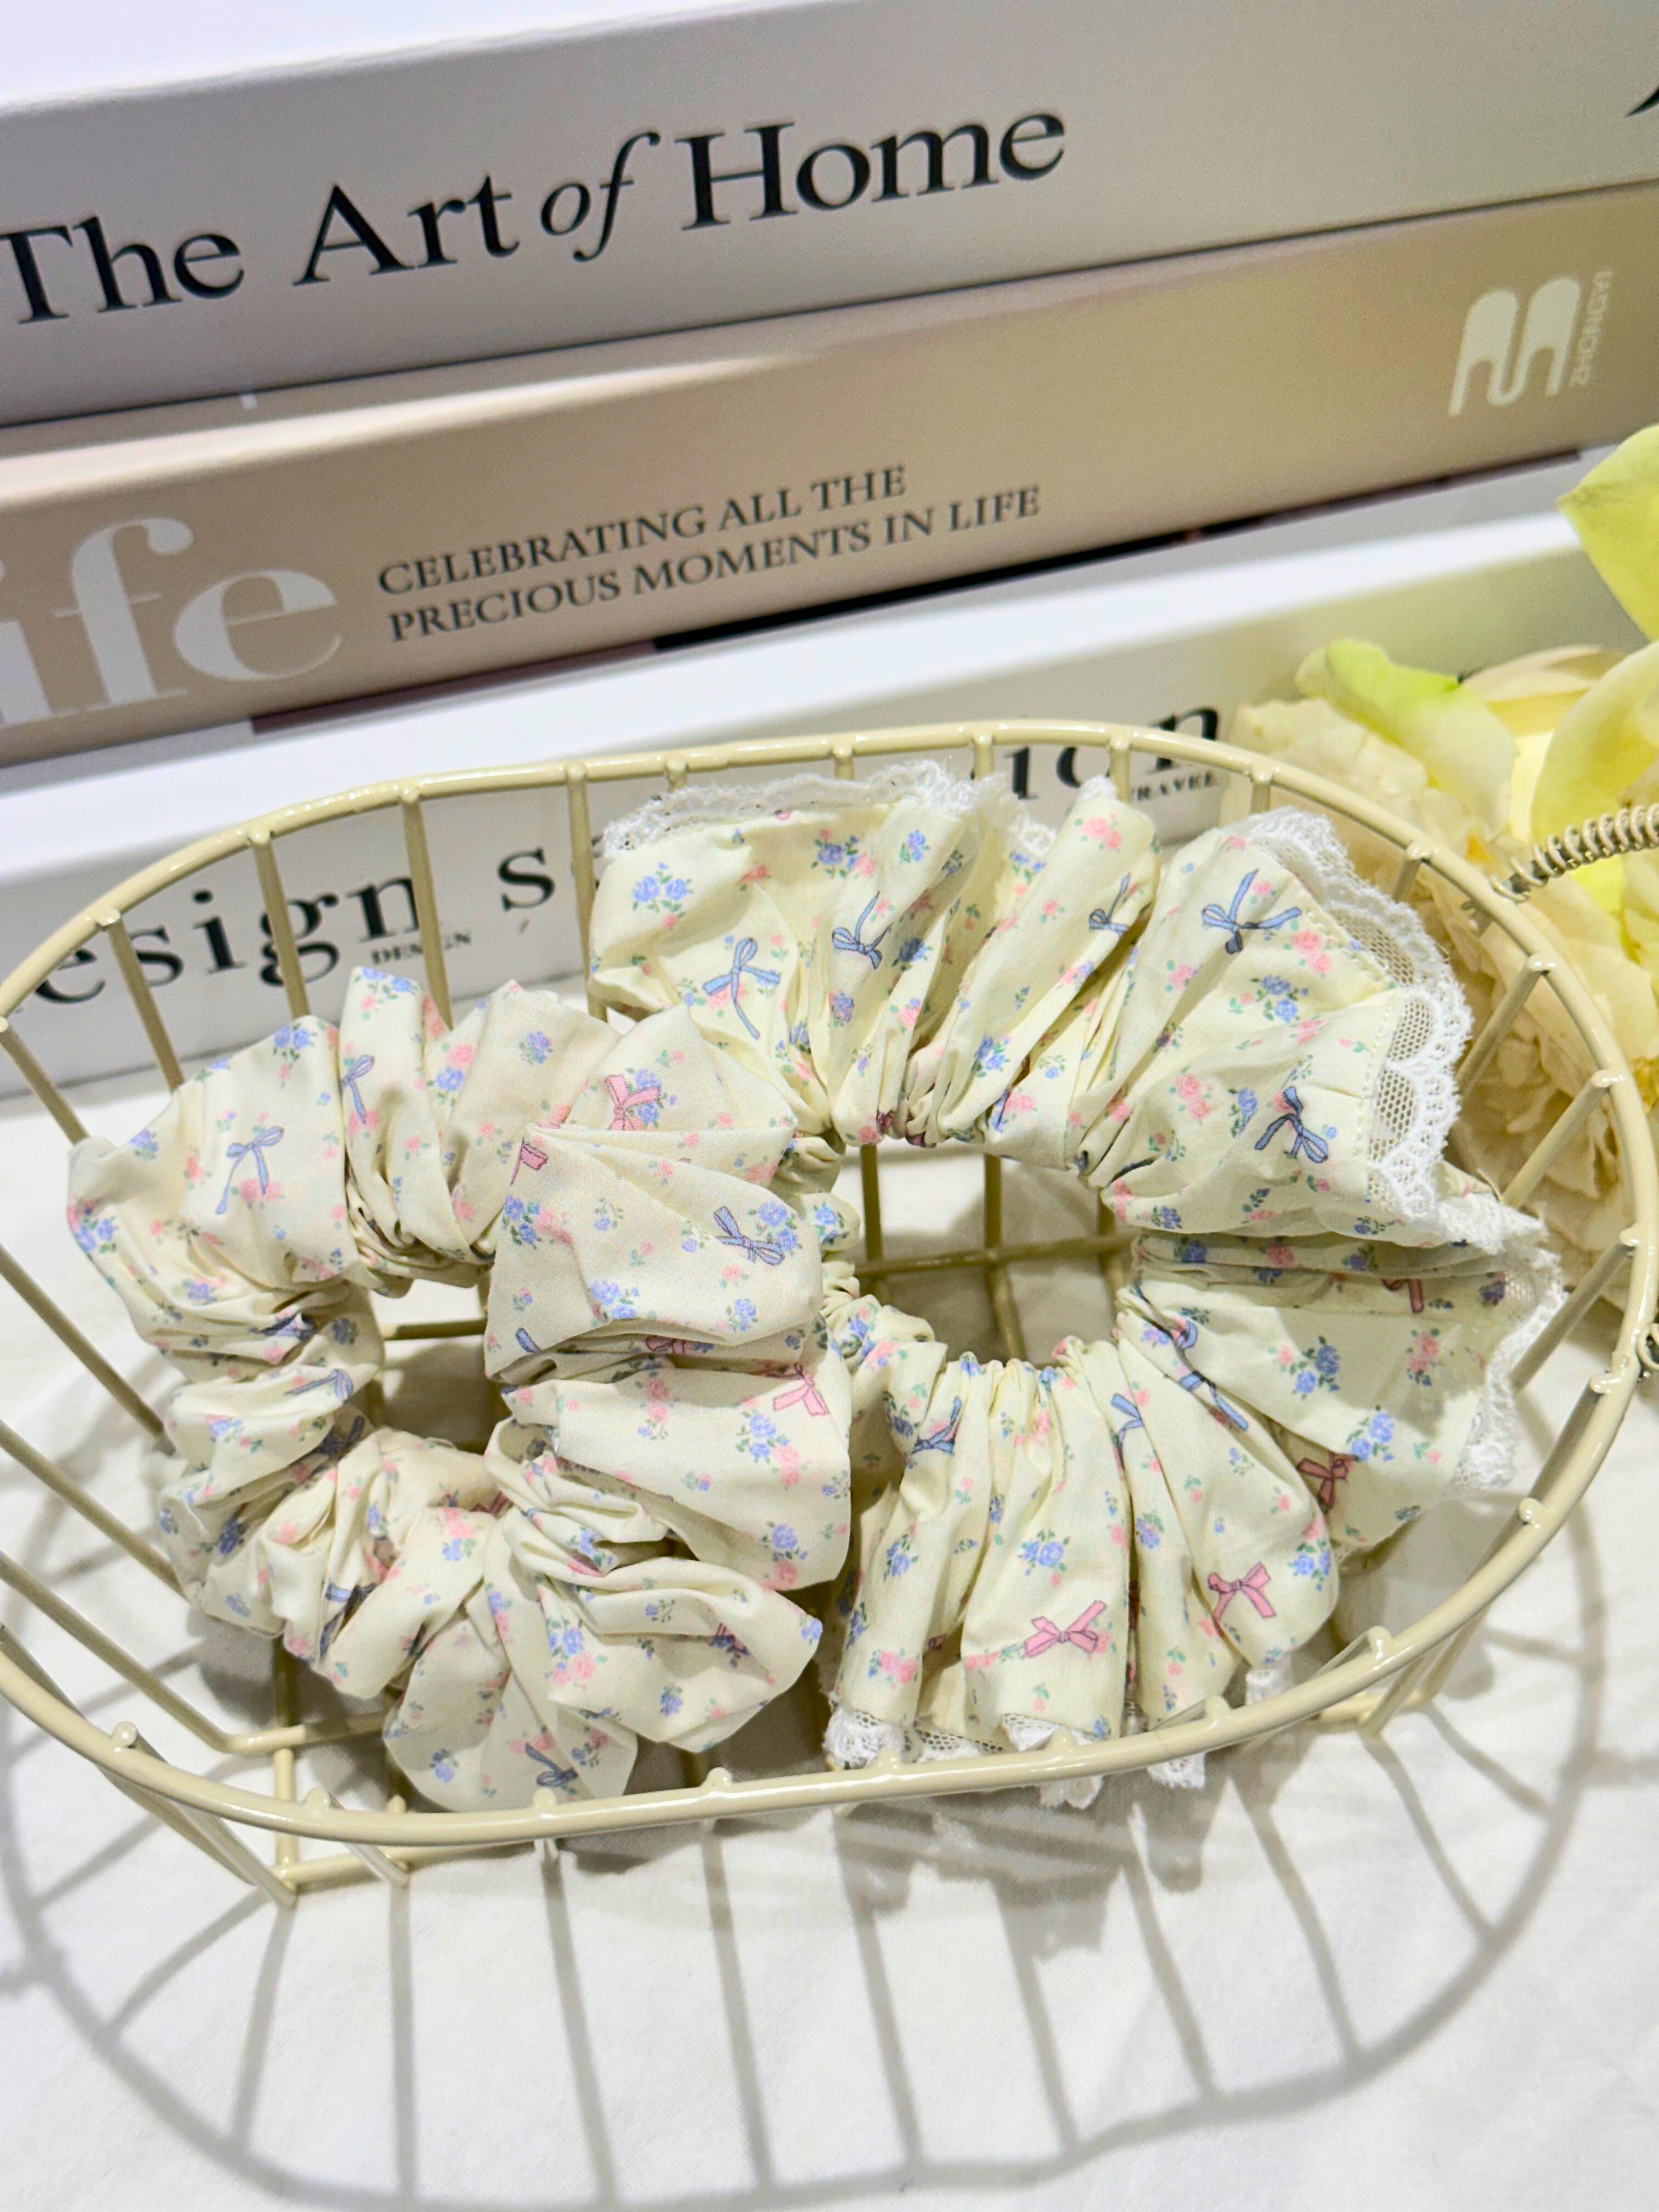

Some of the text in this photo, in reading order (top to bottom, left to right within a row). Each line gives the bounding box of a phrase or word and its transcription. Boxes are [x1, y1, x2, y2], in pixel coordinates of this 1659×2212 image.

[0, 112, 1066, 325] The Art of Home
[379, 464, 906, 595] CELEBRATING ALL THE
[388, 485, 1041, 642] PRECIOUS MOMENTS IN LIFE
[14, 874, 442, 1014] esign
